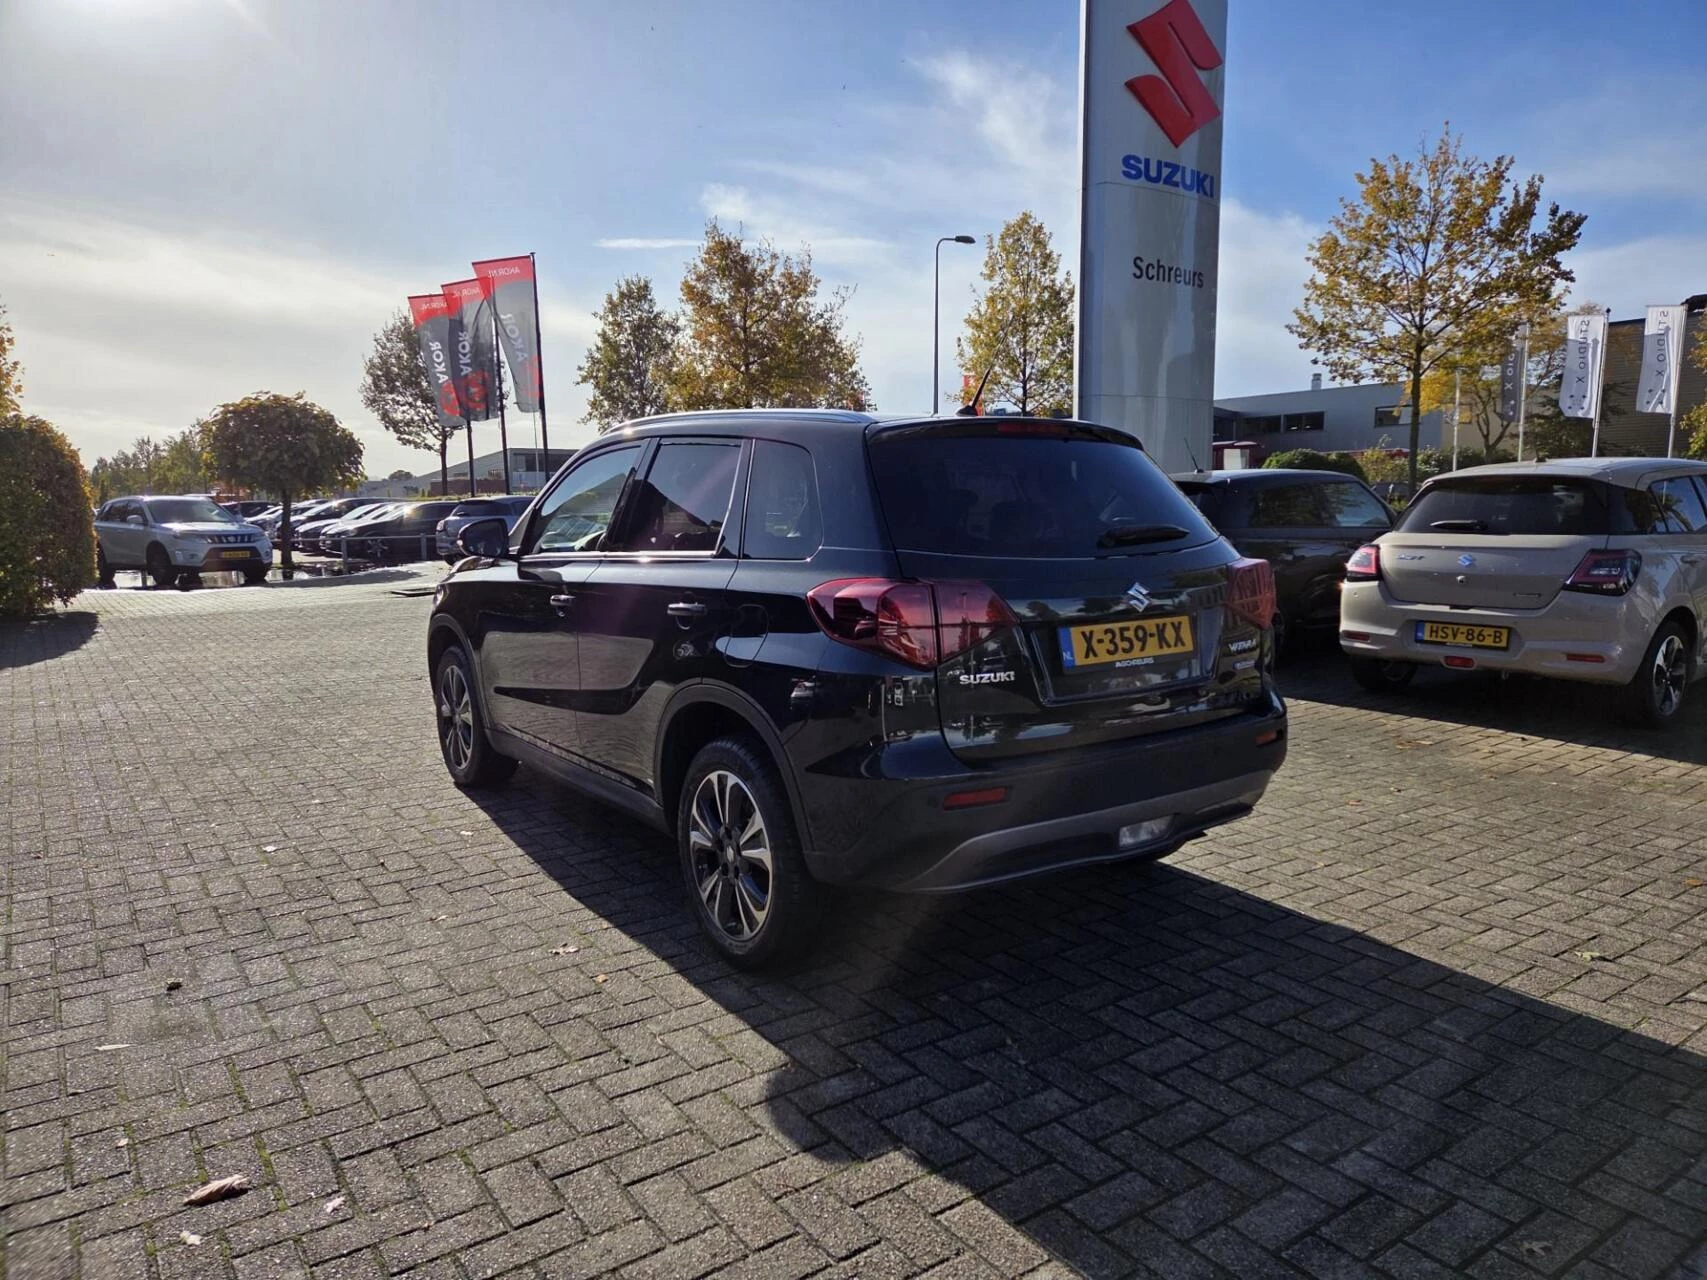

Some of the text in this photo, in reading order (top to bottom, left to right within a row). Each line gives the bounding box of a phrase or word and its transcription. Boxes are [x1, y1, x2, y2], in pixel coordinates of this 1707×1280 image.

[1121, 154, 1214, 198] SUZUKI
[1132, 256, 1204, 288] Schreurs
[1081, 620, 1186, 660] X-359-KX
[1429, 625, 1503, 644] HSV-86-B
[959, 671, 1016, 685] SUZUKI
